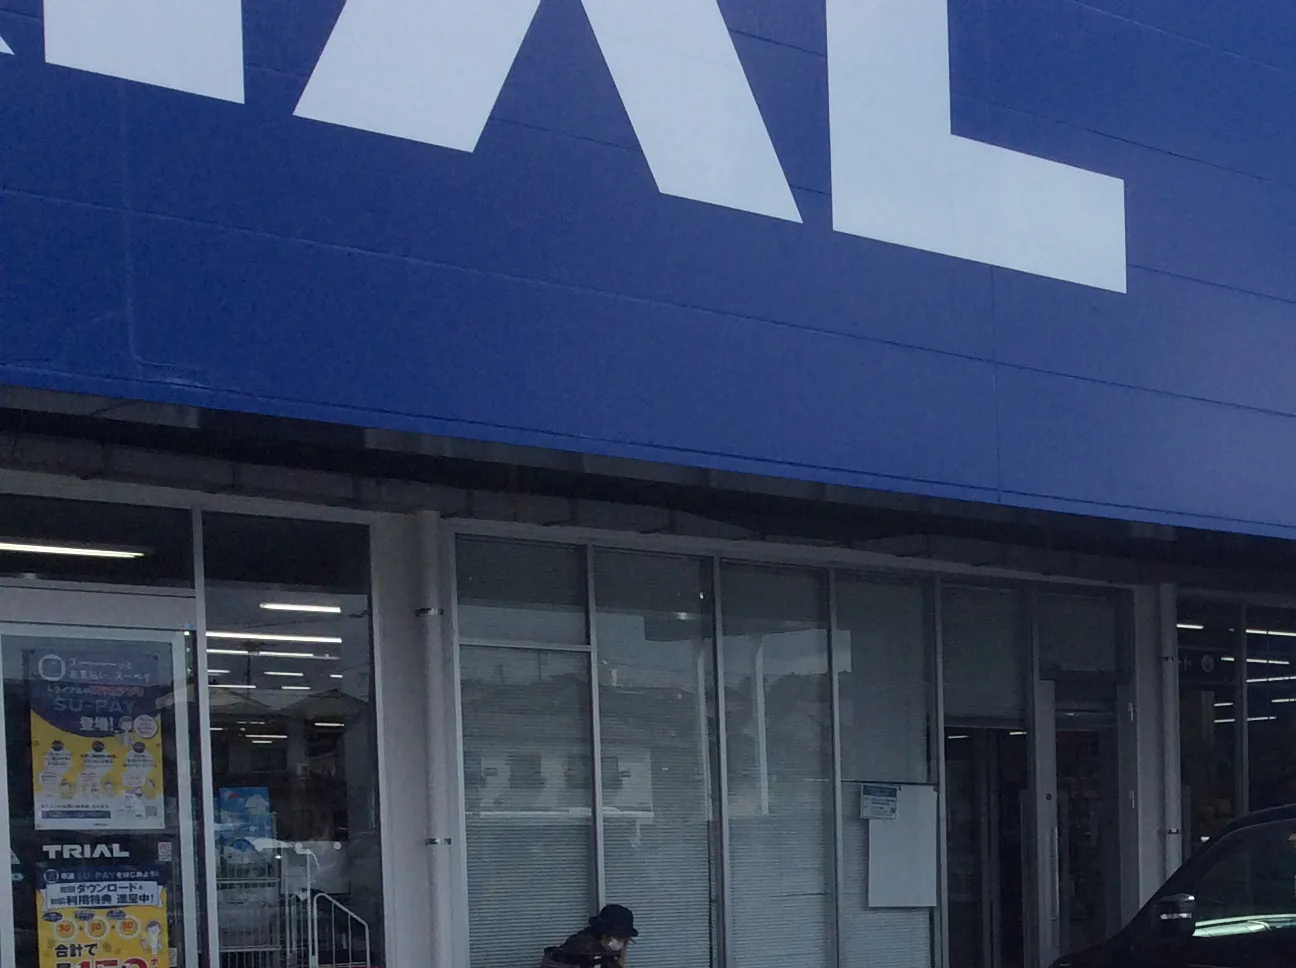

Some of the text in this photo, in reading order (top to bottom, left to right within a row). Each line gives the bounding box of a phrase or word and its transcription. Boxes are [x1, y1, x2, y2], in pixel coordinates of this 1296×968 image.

[53, 697, 135, 713] SU-PAY
[42, 843, 130, 859] TRIAL
[55, 943, 98, 958] 合計で
